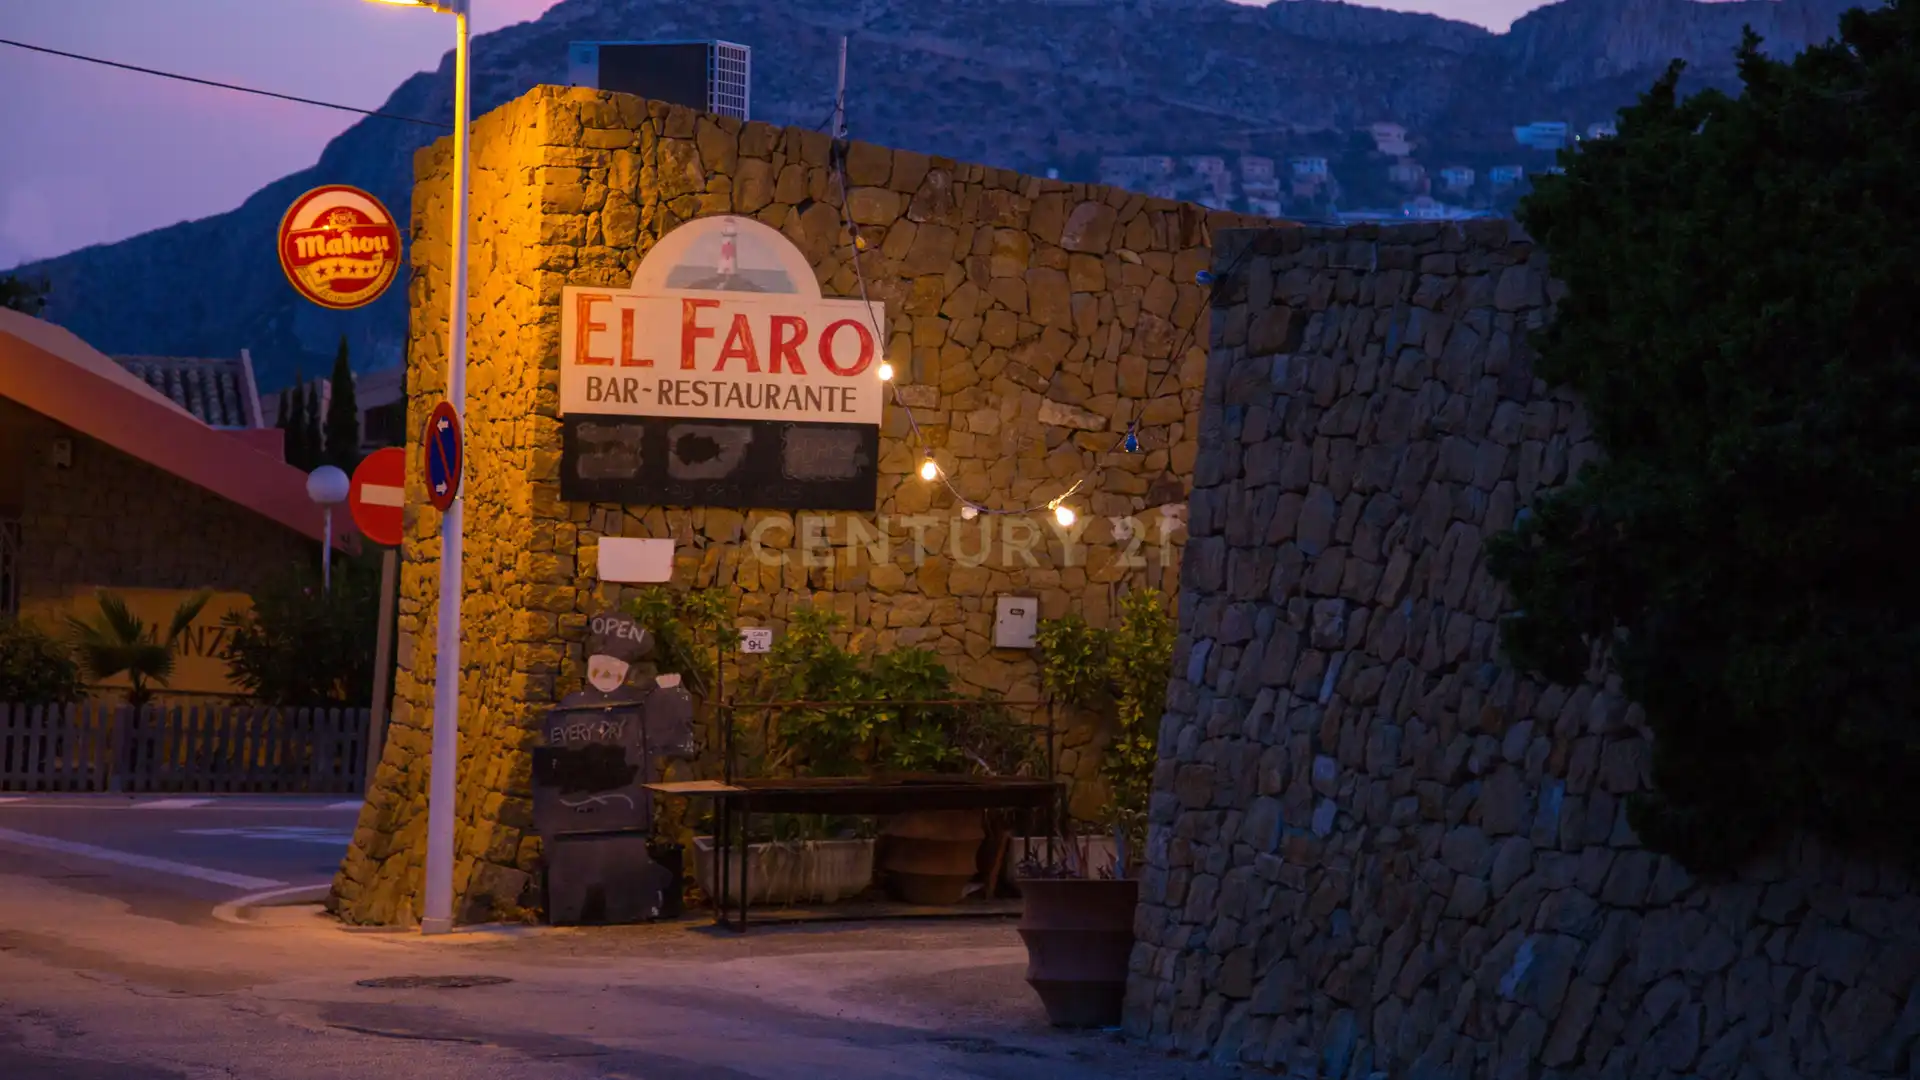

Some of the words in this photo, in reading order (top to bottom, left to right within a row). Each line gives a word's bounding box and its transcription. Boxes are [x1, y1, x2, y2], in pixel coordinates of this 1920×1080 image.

[294, 231, 390, 258] Mahou
[574, 293, 654, 368] EL
[680, 298, 875, 377] FARO
[586, 376, 857, 413] BAR-RESTAURANTE
[592, 618, 645, 643] OPEN
[550, 722, 595, 744] EVERY
